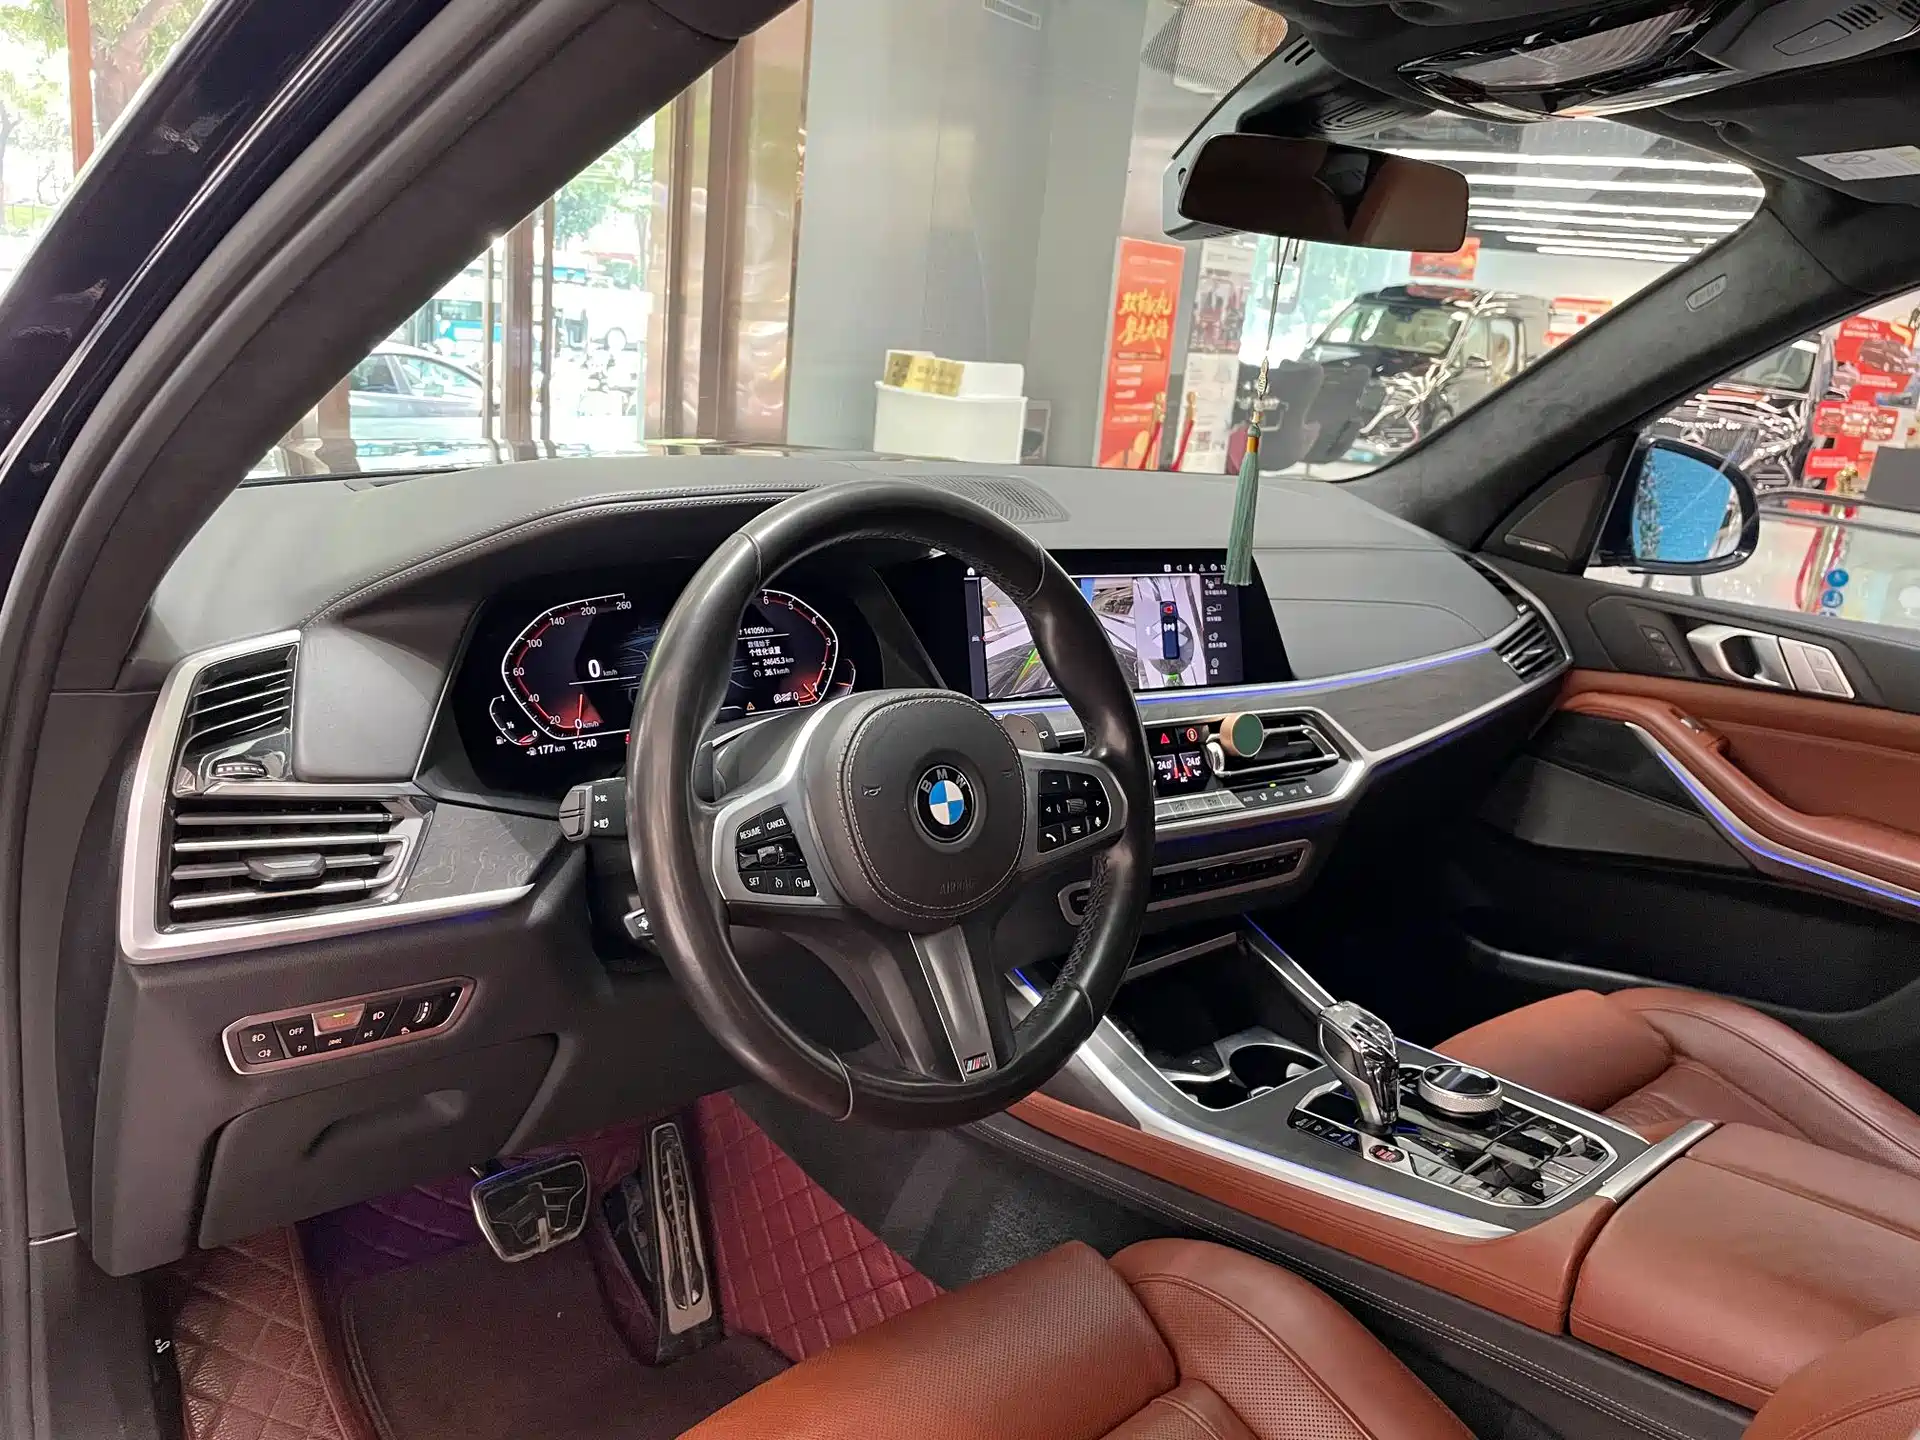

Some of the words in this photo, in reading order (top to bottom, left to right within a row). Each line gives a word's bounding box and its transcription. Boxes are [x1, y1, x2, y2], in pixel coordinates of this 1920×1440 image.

[616, 601, 632, 610] 260
[763, 596, 769, 605] 6
[788, 601, 794, 610] 5
[580, 606, 597, 616] 200
[550, 616, 565, 626] 140
[811, 616, 817, 625] 4
[743, 626, 765, 635] 141050
[527, 639, 543, 648] 100
[826, 637, 832, 646] 3
[588, 659, 601, 679] 0
[602, 669, 618, 677] km/h
[821, 661, 828, 671] 2
[513, 667, 525, 677] 60
[812, 682, 818, 692] 1
[528, 693, 540, 703] 40
[793, 691, 799, 701] 0
[549, 715, 561, 726] 20
[574, 718, 583, 730] 0
[582, 720, 600, 730] km/h
[532, 730, 538, 738] 0
[537, 744, 554, 755] 177
[554, 744, 566, 753] km
[573, 738, 598, 751] 12:40
[921, 768, 967, 794] BMW
[766, 818, 787, 831] CANCEL
[739, 826, 762, 840] RESUME
[748, 876, 760, 887] SET
[801, 879, 811, 888] LIM
[288, 1026, 305, 1037] OFF
